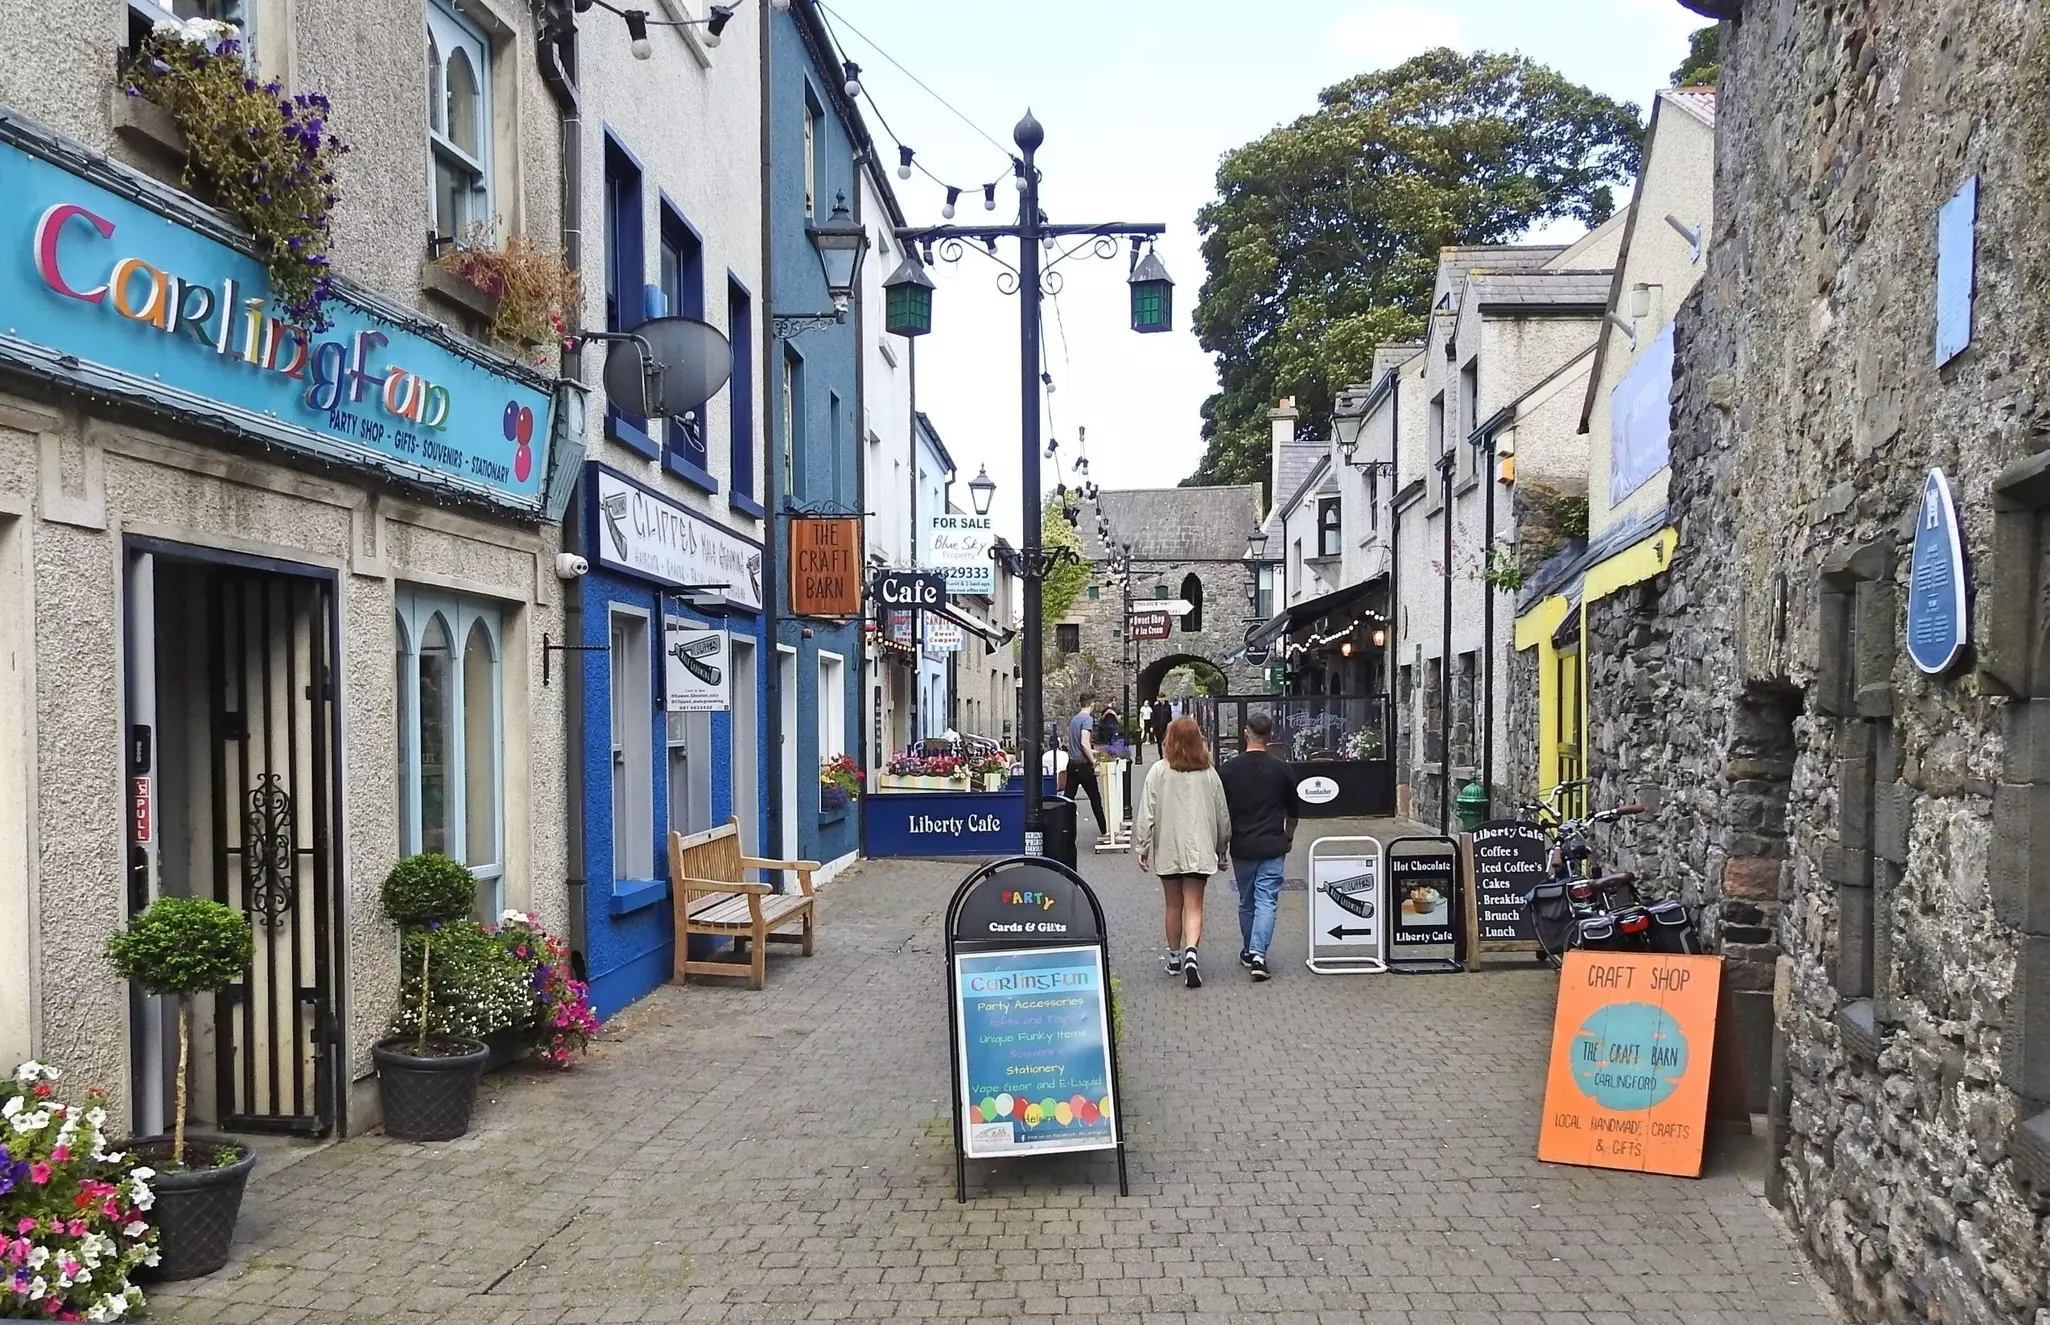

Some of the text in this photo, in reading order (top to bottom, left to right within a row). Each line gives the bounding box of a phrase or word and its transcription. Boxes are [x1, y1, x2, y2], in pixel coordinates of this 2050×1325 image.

[330, 411, 359, 436] PARTY
[360, 418, 385, 443] SHOP
[422, 439, 463, 469] SOUVENIRS
[471, 456, 510, 485] STATIONARY
[633, 491, 698, 555] CLIPPED
[933, 518, 991, 529] FOR SALE
[813, 524, 838, 546] THE
[935, 534, 988, 556] Blue Sky
[799, 550, 849, 573] CRAFT
[806, 577, 843, 599] BARN
[882, 579, 937, 604] Cafe
[1134, 615, 1165, 626] Sweet Shop
[1140, 627, 1148, 635] Ice
[1149, 626, 1164, 635] Cream
[136, 799, 146, 840] PULL
[909, 814, 1001, 837] Liberty Cafe
[1473, 826, 1544, 843] Liberty Cafe
[1393, 861, 1451, 872] Hot Chocolate
[1481, 862, 1543, 873] Iced Coffee's
[1482, 878, 1511, 889] Cakes
[1001, 889, 1055, 911] PARTY
[1484, 910, 1520, 921] Brunch
[989, 922, 1067, 933] Cards & Gifts
[1485, 926, 1516, 937] Lunch
[1396, 931, 1453, 944] Liberty Cafe
[1588, 965, 1691, 992] CRAFT SHOP
[977, 997, 1085, 1014] Party Accessories
[980, 1029, 1087, 1047] Unique Funky Items
[1583, 1041, 1679, 1067] THE CRAFT BARN
[1006, 1064, 1065, 1079] Stationery
[972, 1075, 1102, 1097] Vape Gear and E-Liquid
[1594, 1072, 1657, 1091] CARLINGFORD
[1554, 1113, 1690, 1140] LOCAL HANDMADE CRAFTS
[1596, 1139, 1604, 1152] &
